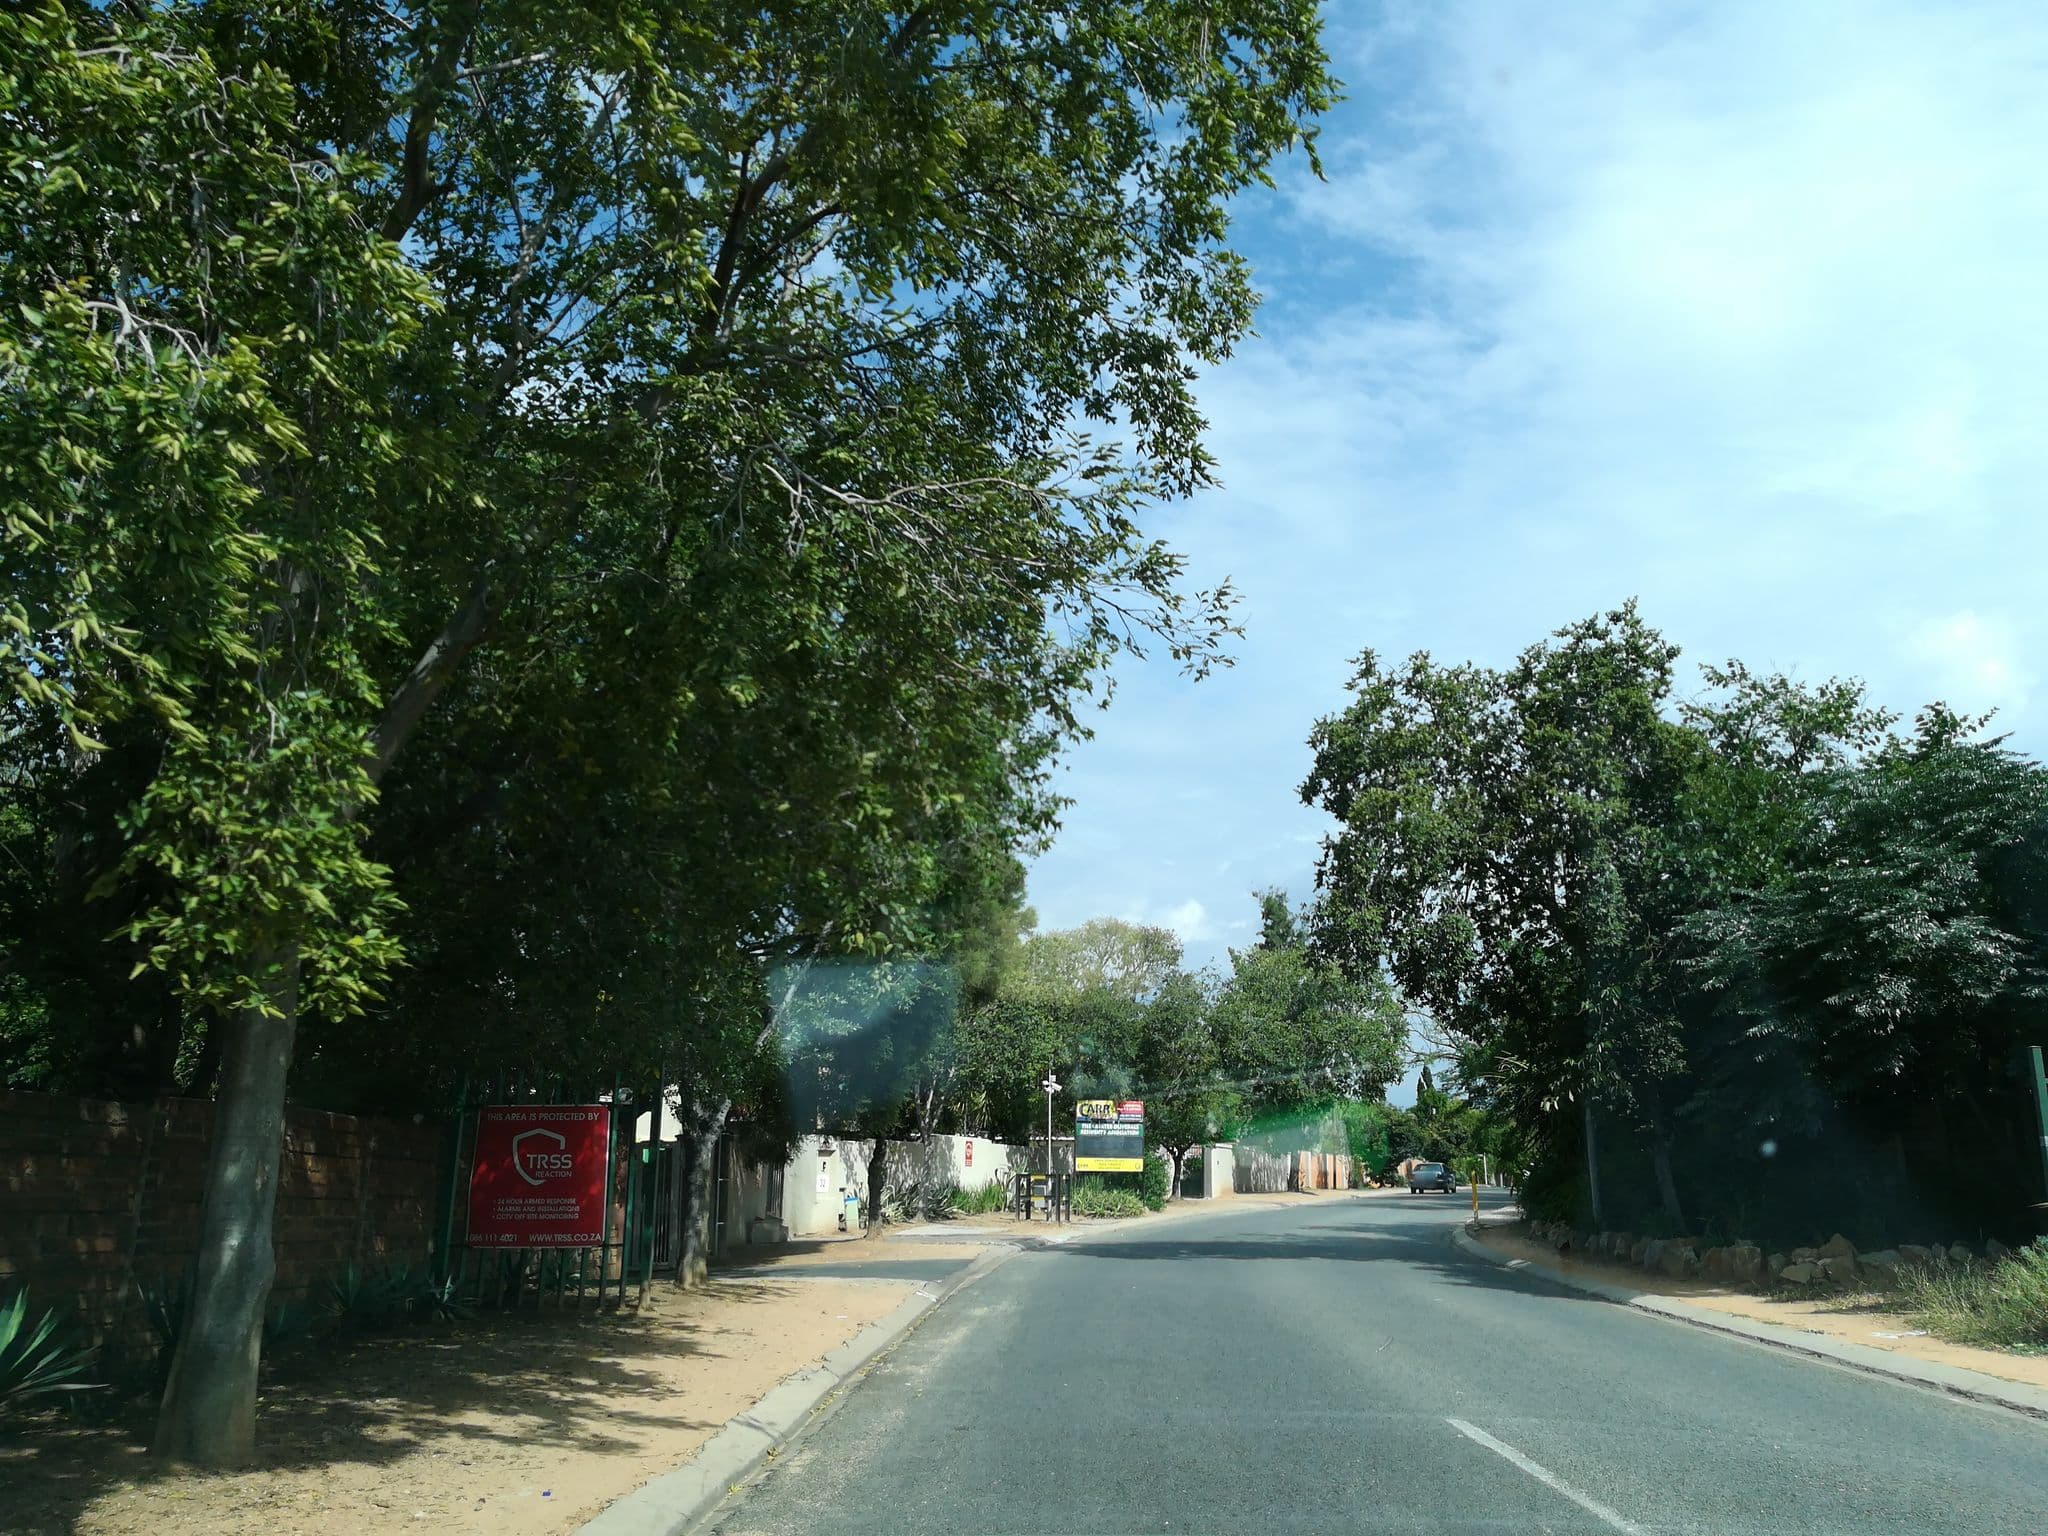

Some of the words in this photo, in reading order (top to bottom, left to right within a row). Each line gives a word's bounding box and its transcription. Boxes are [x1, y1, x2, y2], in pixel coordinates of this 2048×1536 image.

[1079, 1103, 1110, 1116] CARR
[488, 1112, 503, 1120] THIS
[506, 1112, 527, 1120] AREA
[529, 1112, 537, 1120] IS
[539, 1112, 586, 1120] PROTECTED
[587, 1112, 600, 1120] BY
[526, 1154, 573, 1169] TRSS
[535, 1170, 572, 1178] REACTION
[499, 1233, 518, 1242] 4021
[528, 1233, 601, 1242] WWW.TRSS.CO.ZA
